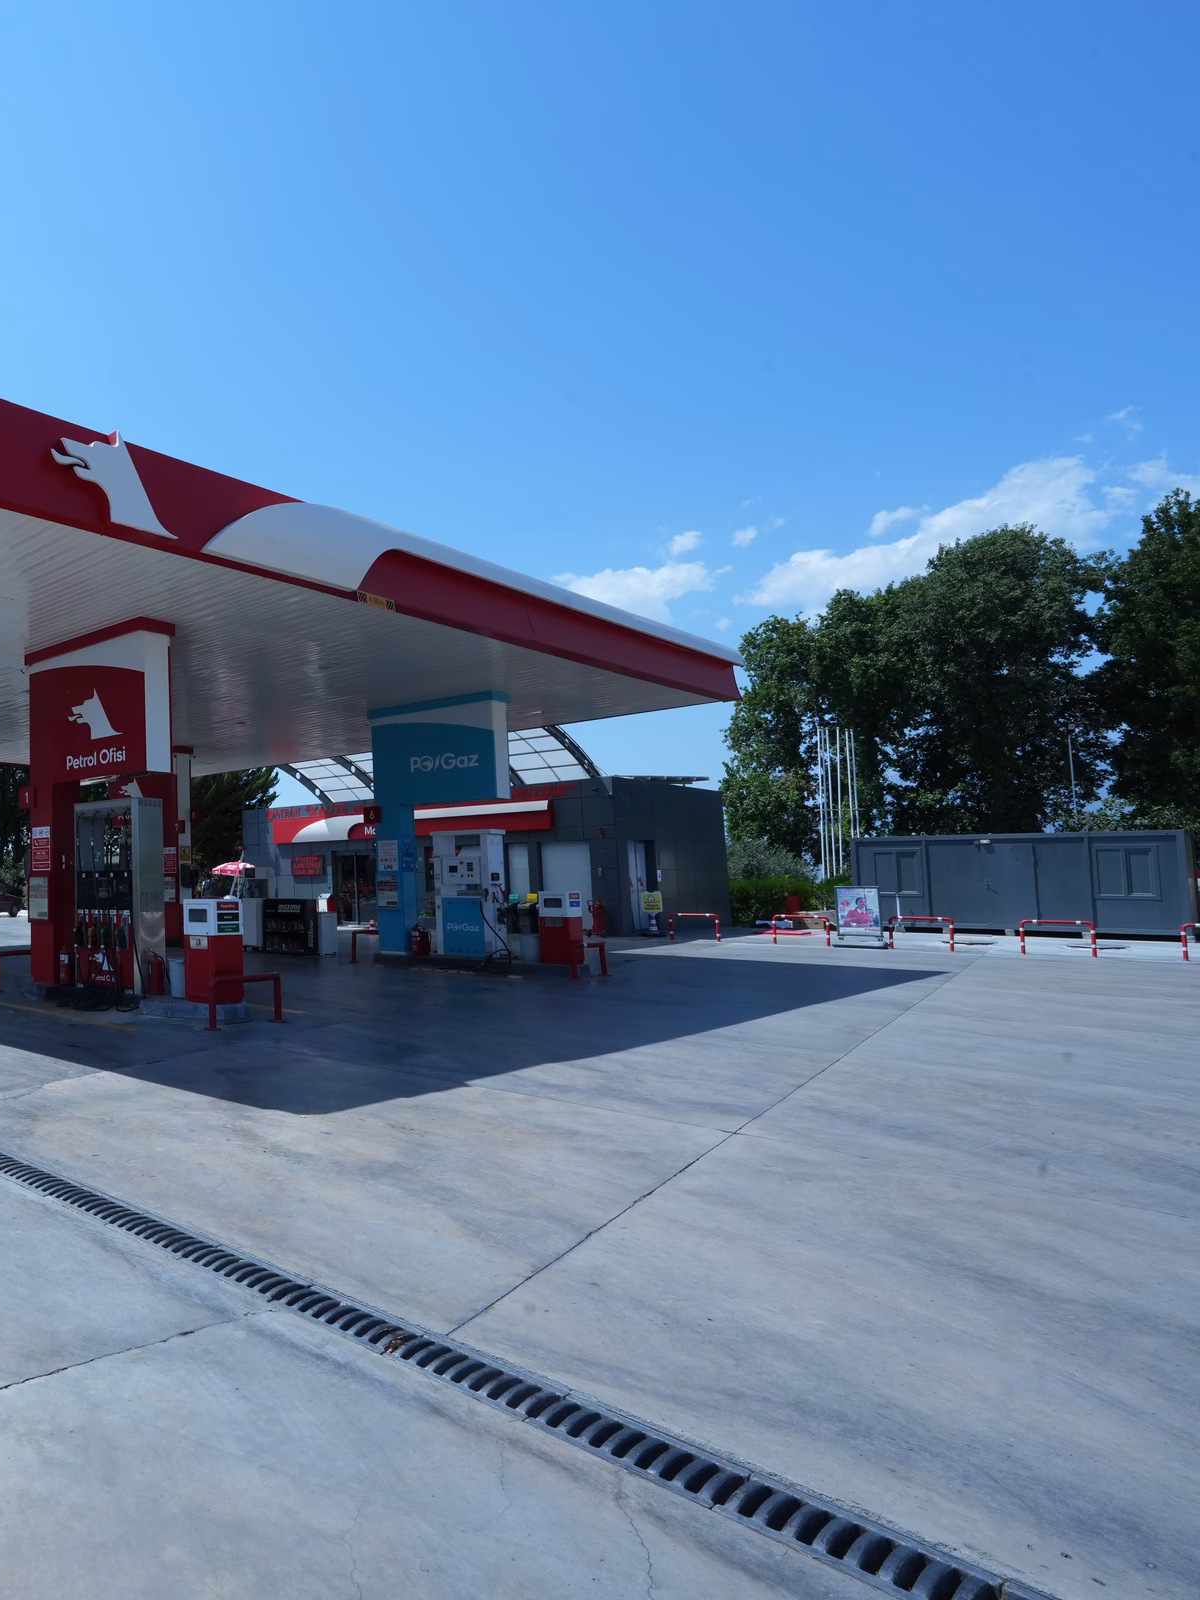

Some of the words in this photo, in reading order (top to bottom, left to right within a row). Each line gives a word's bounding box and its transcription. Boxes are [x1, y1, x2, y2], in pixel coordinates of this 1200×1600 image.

[66, 751, 97, 771] Petrol
[99, 746, 126, 765] Ofisi
[369, 810, 375, 820] 6
